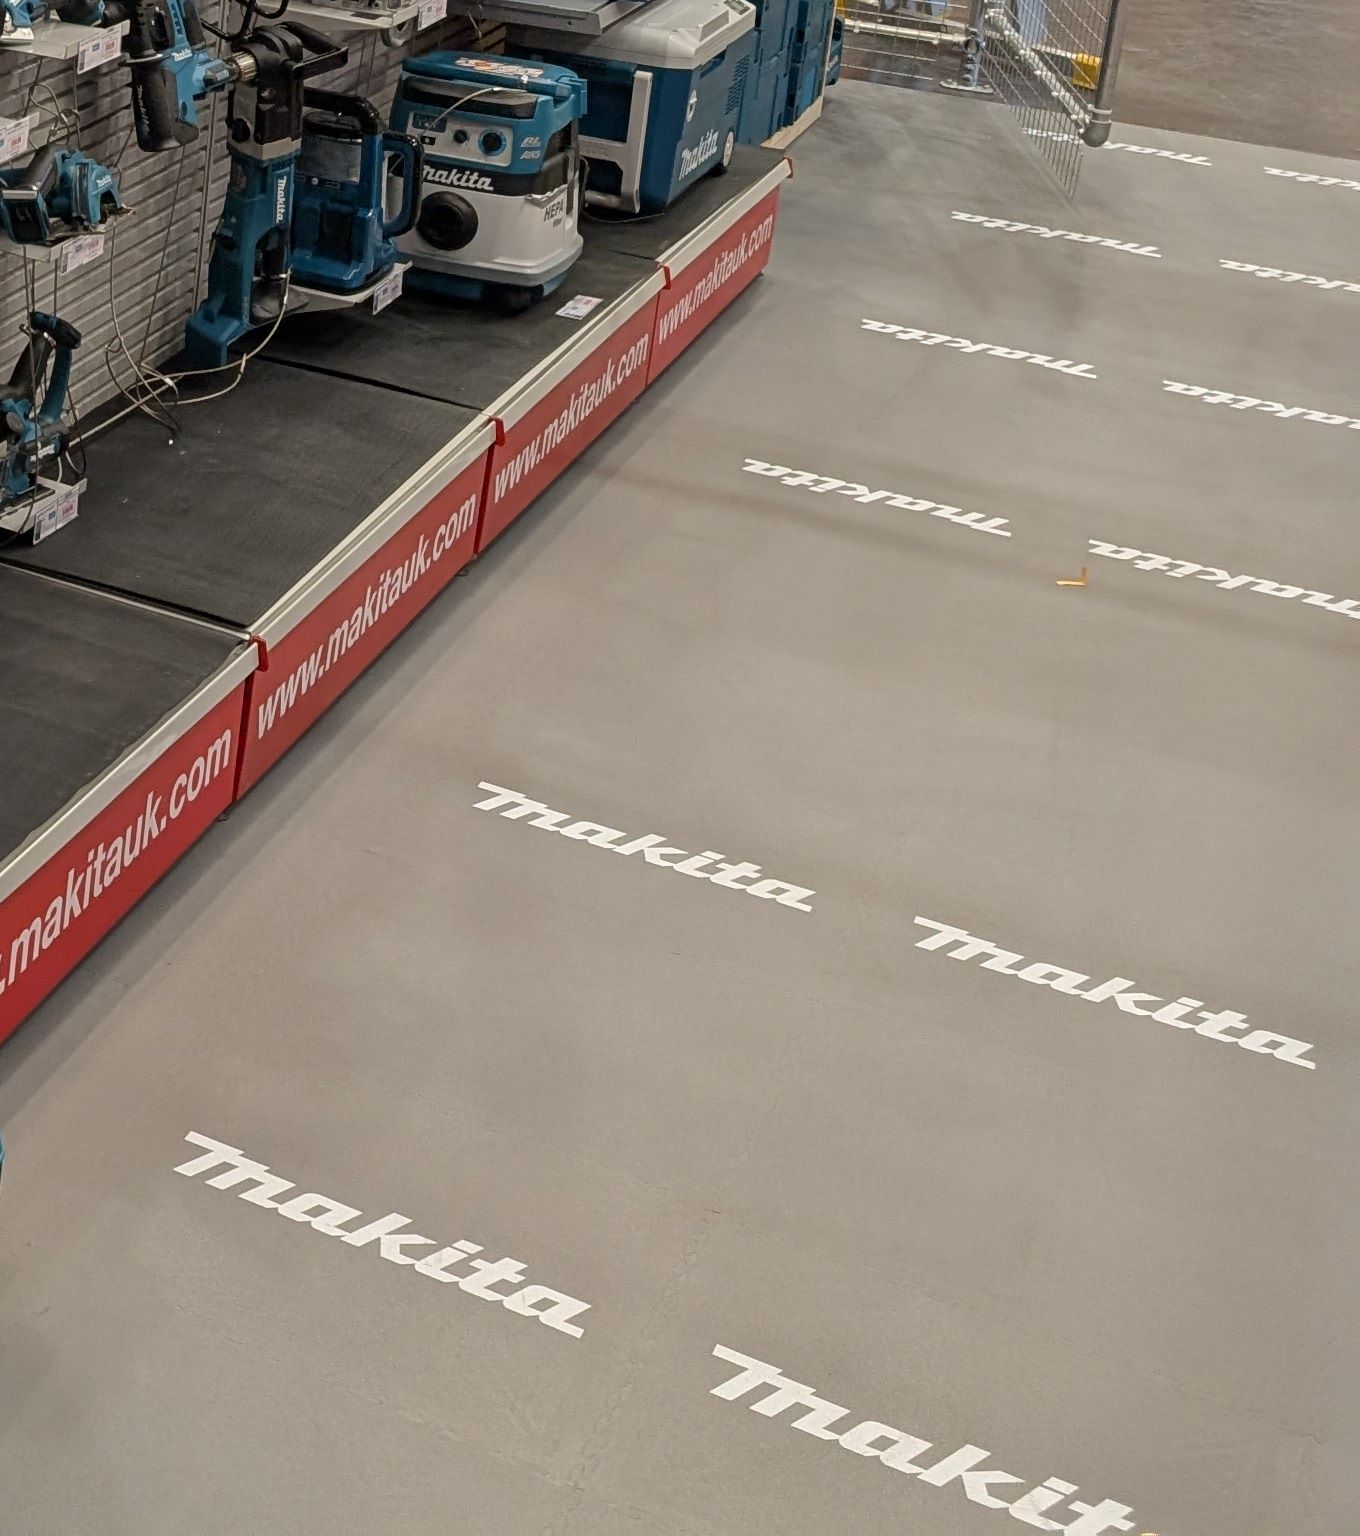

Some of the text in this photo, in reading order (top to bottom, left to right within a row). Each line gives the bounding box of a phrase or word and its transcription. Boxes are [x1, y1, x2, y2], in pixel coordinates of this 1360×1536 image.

[543, 199, 565, 222] HEPA
[657, 211, 775, 346] www.makitauk.com
[492, 331, 649, 506] www.makitauk.com
[256, 492, 476, 741] www.makitauk.com
[473, 781, 814, 912] Makita
[913, 916, 1316, 1070] Makita
[173, 1131, 592, 1339] Makita
